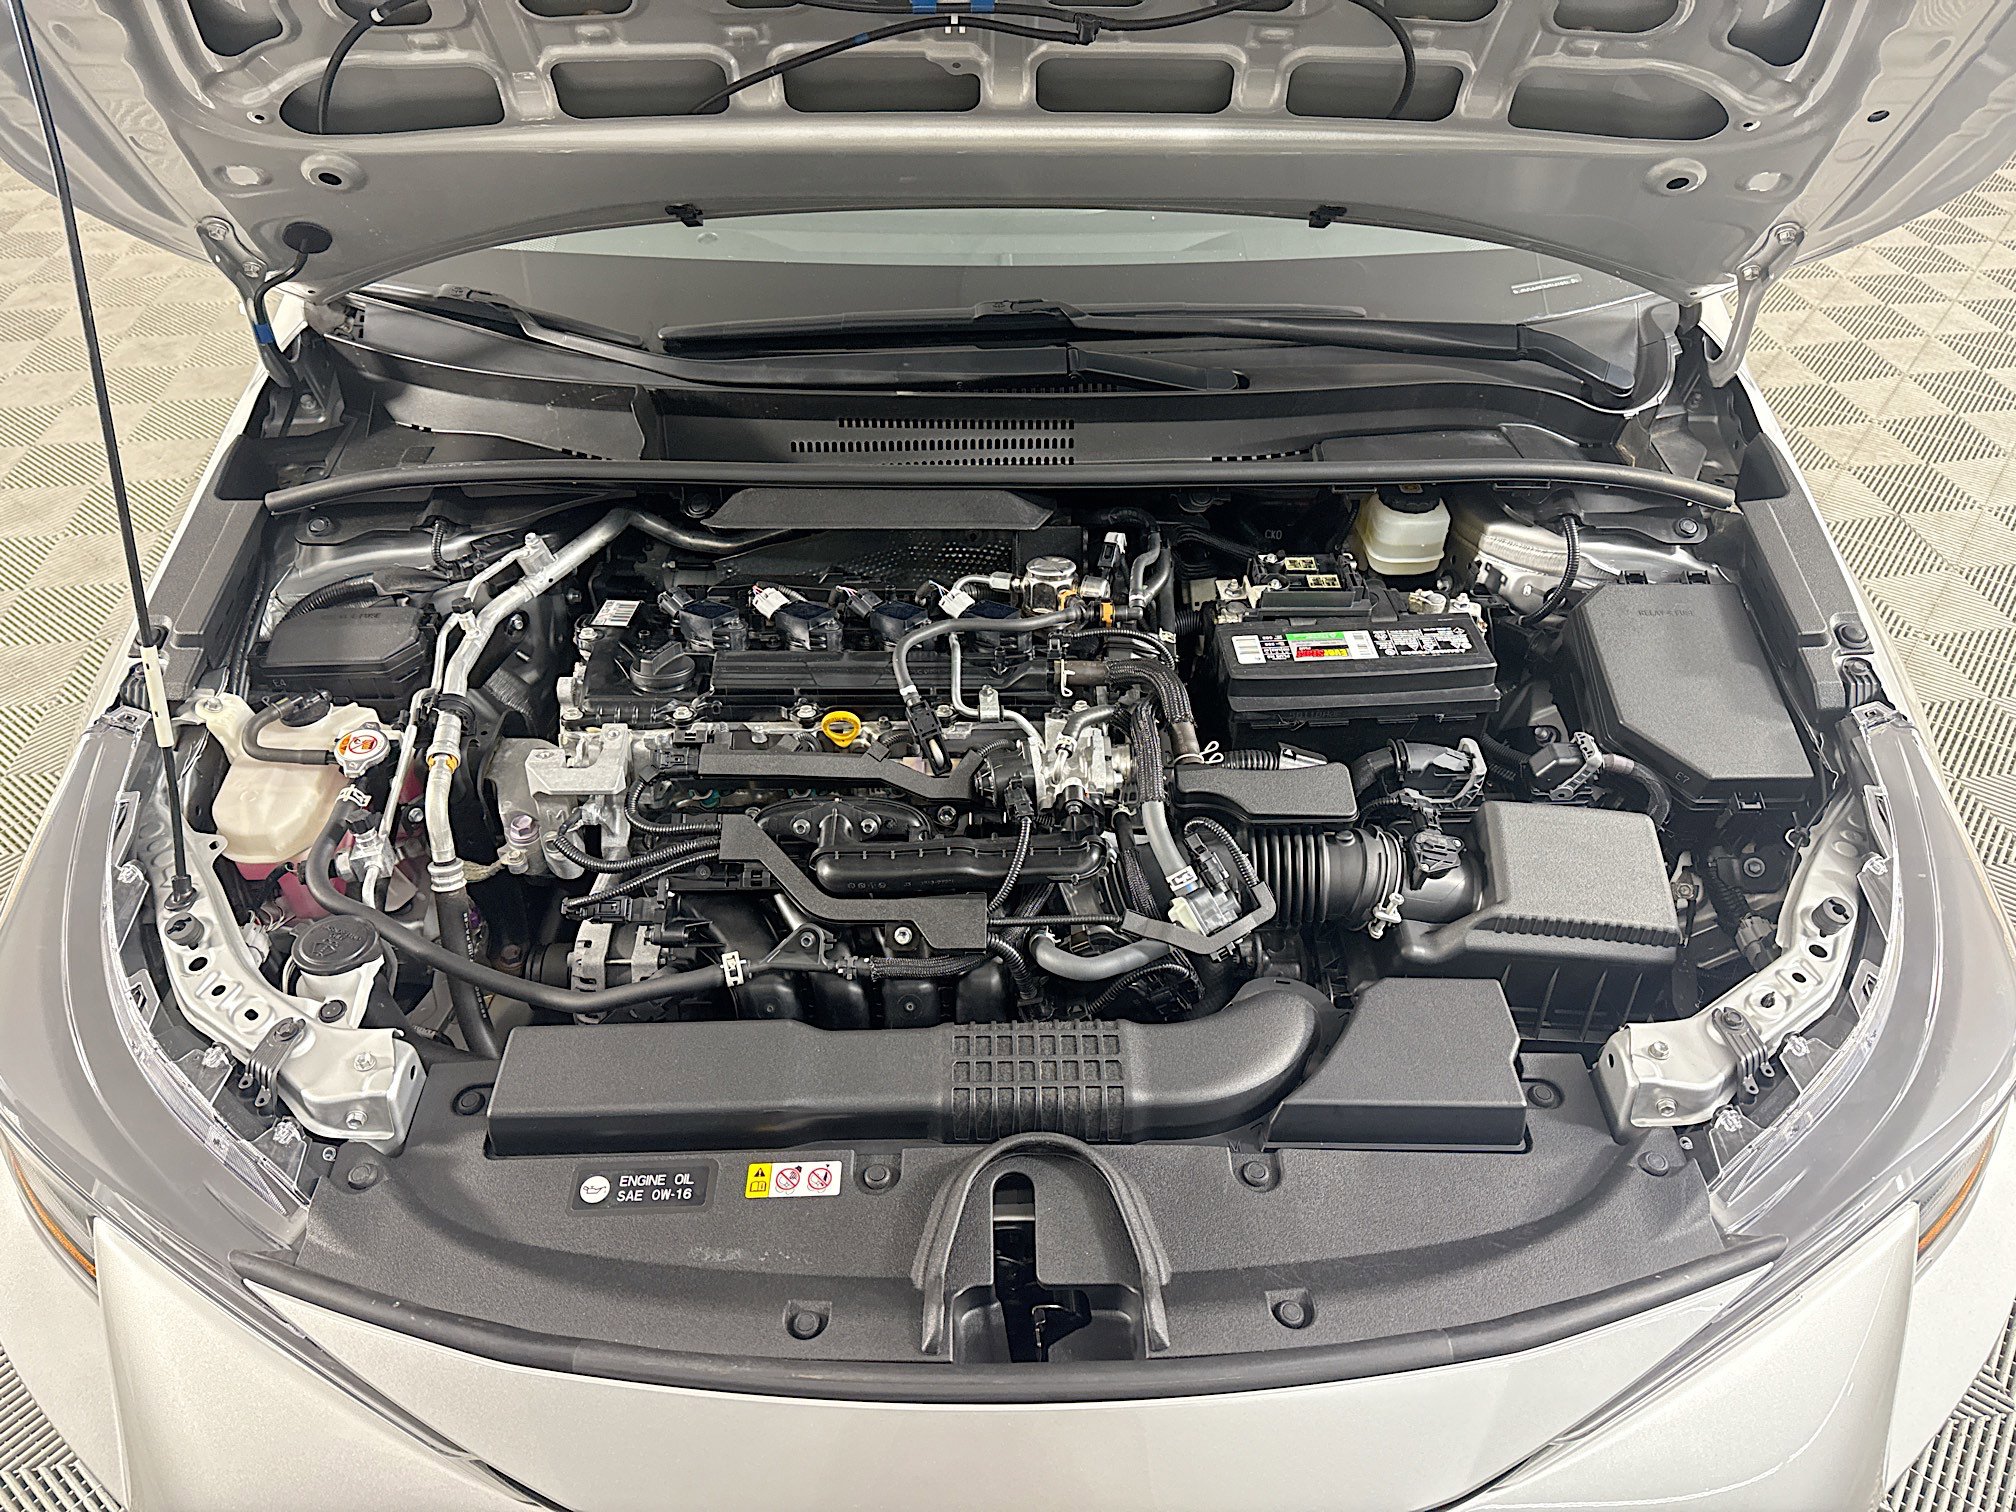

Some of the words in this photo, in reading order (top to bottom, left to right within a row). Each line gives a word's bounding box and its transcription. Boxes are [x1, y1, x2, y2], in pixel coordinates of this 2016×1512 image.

[619, 1174, 667, 1187] ENGINE
[674, 1173, 695, 1186] OIL
[616, 1190, 643, 1202] SAE
[651, 1188, 693, 1201] 0W-16
